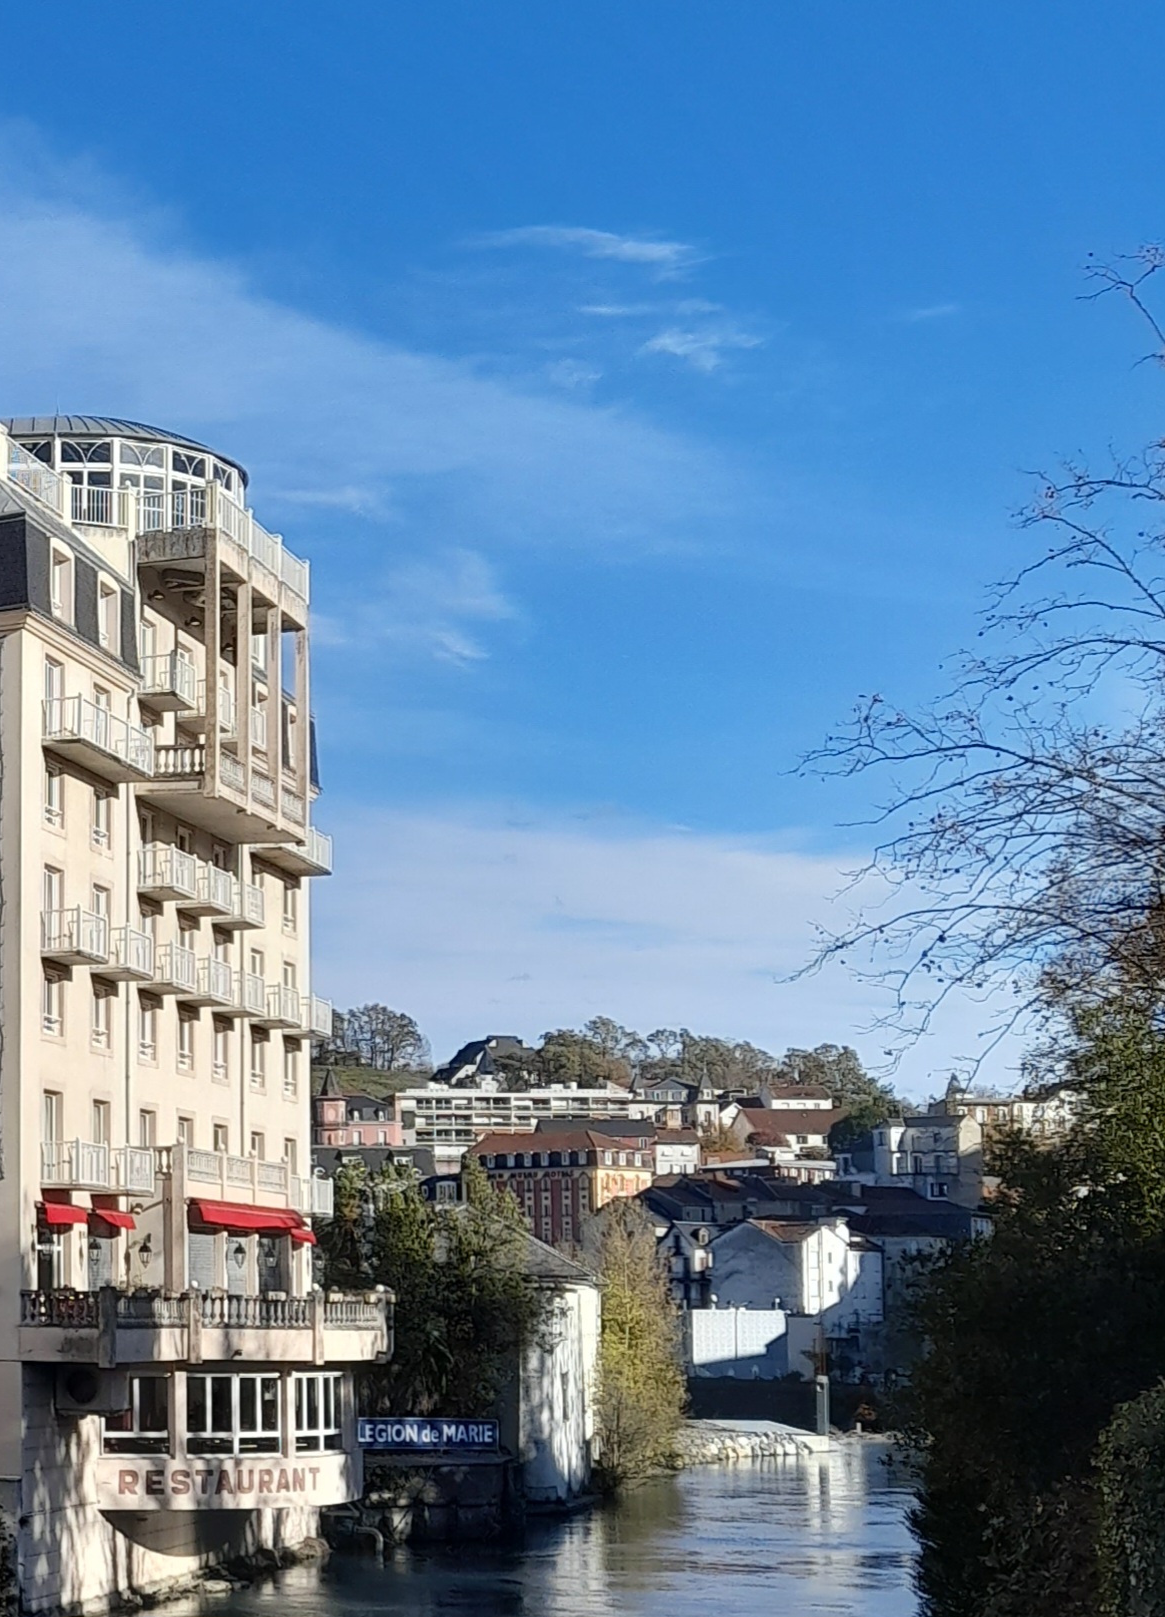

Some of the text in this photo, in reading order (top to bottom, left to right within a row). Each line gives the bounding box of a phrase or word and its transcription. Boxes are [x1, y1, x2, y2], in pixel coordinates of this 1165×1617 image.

[358, 1424, 493, 1443] LEGION de MARIE
[118, 1467, 320, 1496] RESTAURANT
